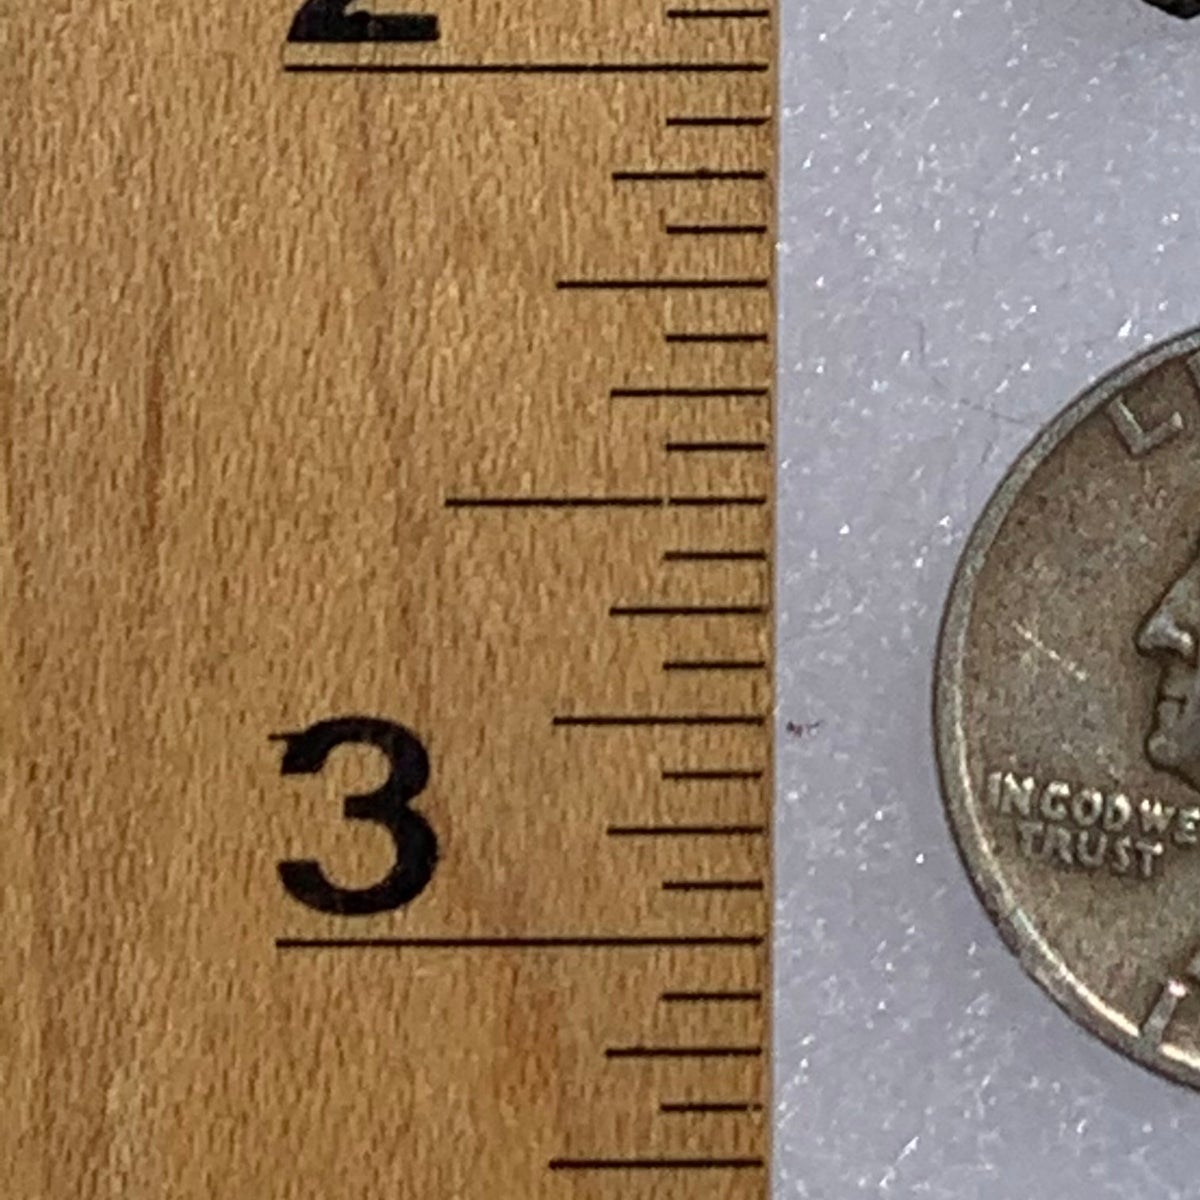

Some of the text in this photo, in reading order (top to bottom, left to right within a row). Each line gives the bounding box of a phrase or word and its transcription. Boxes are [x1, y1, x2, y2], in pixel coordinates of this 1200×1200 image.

[272, 715, 439, 917] 3
[988, 771, 1200, 844] IN GOD WE
[1016, 820, 1164, 877] TRUST
